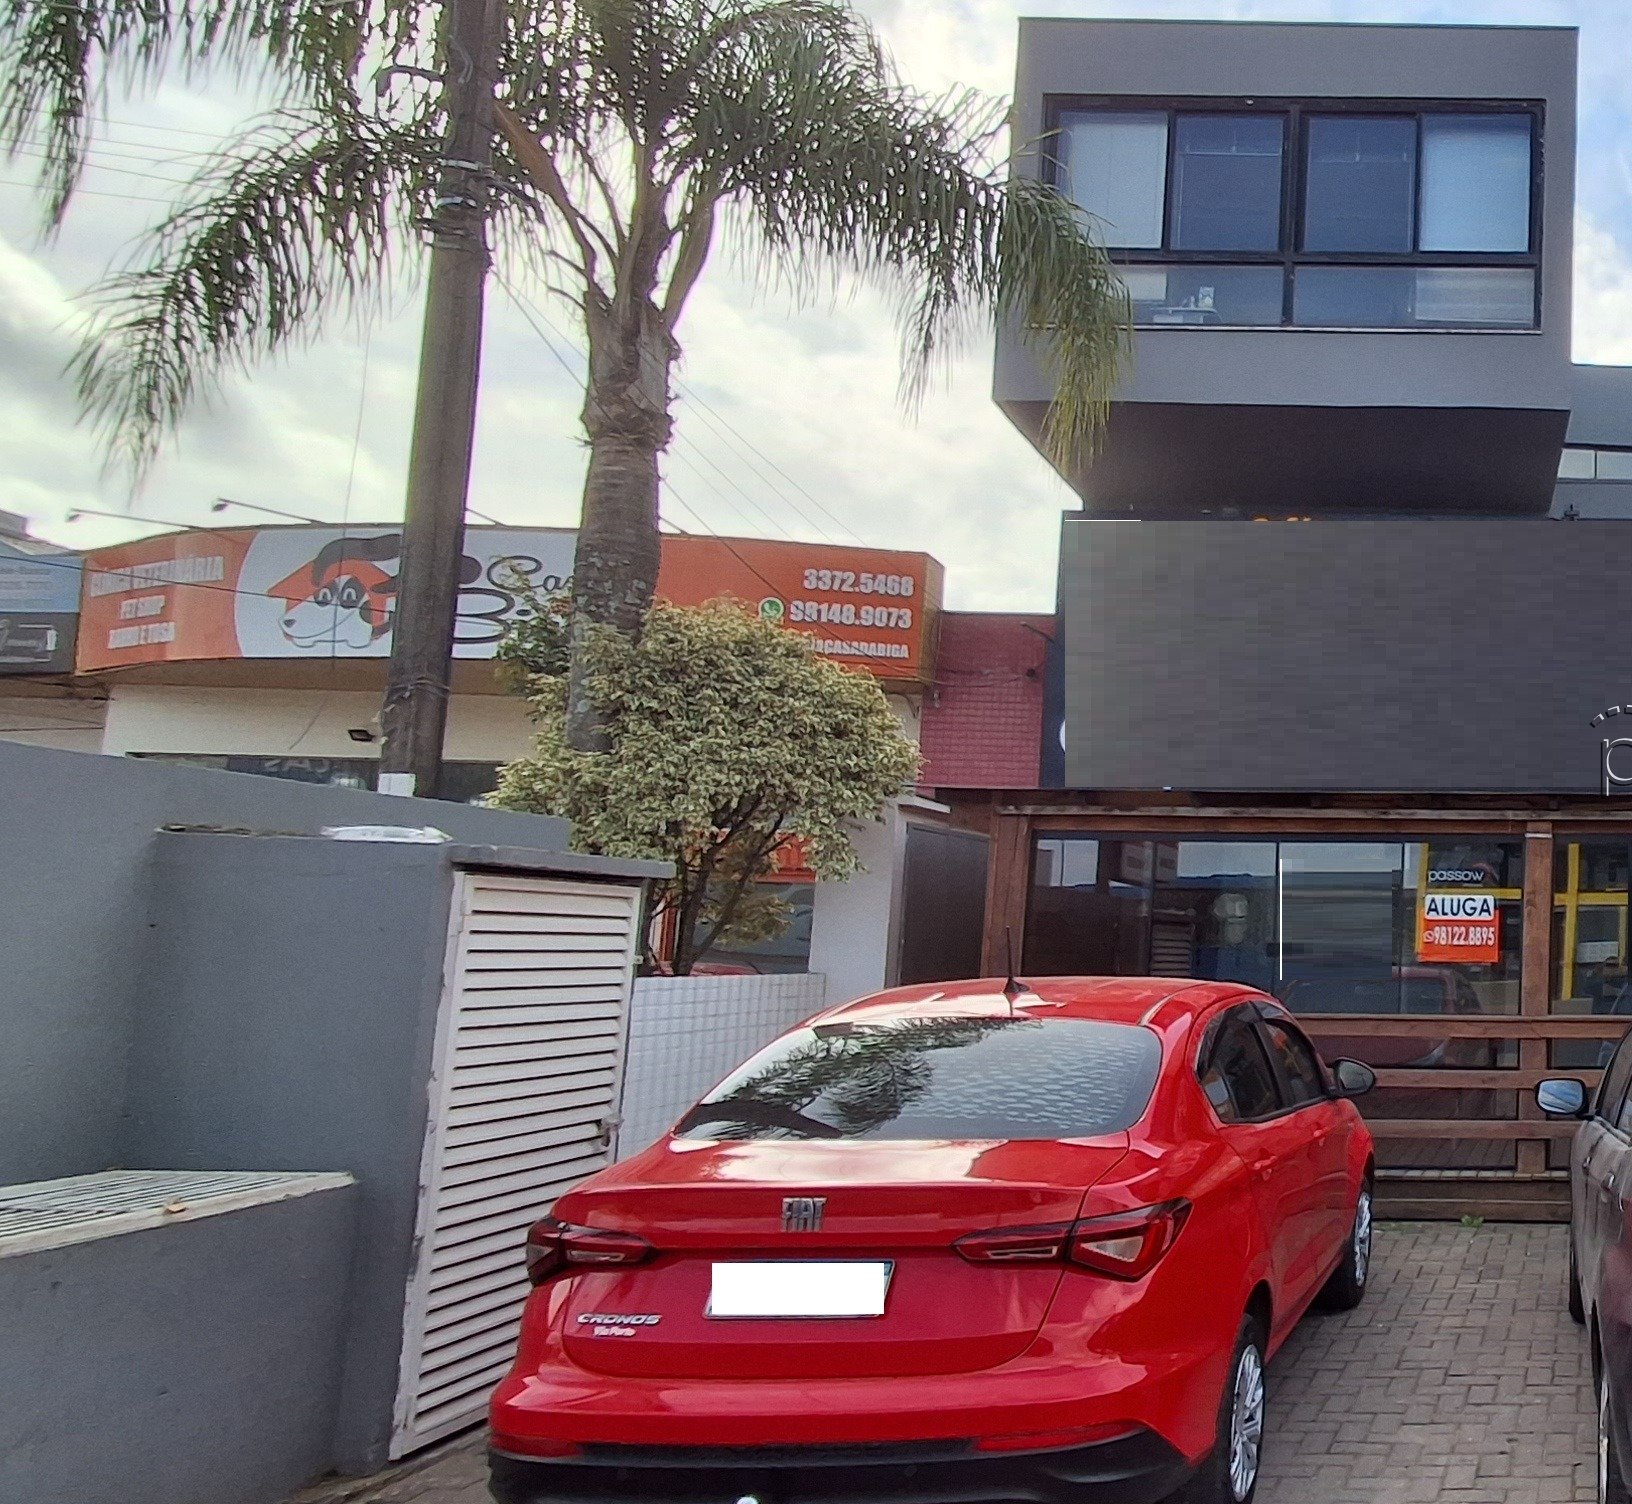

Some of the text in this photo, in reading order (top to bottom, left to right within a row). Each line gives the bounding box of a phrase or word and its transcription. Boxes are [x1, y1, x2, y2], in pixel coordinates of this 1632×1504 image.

[803, 568, 915, 598] 3372.5468
[789, 600, 913, 629] 98148.9073
[1428, 870, 1485, 882] passow
[1426, 897, 1492, 917] ALUGA
[1433, 926, 1496, 946] 98122.8895
[781, 1197, 828, 1233] FIAT
[577, 1313, 662, 1325] CRONOS
